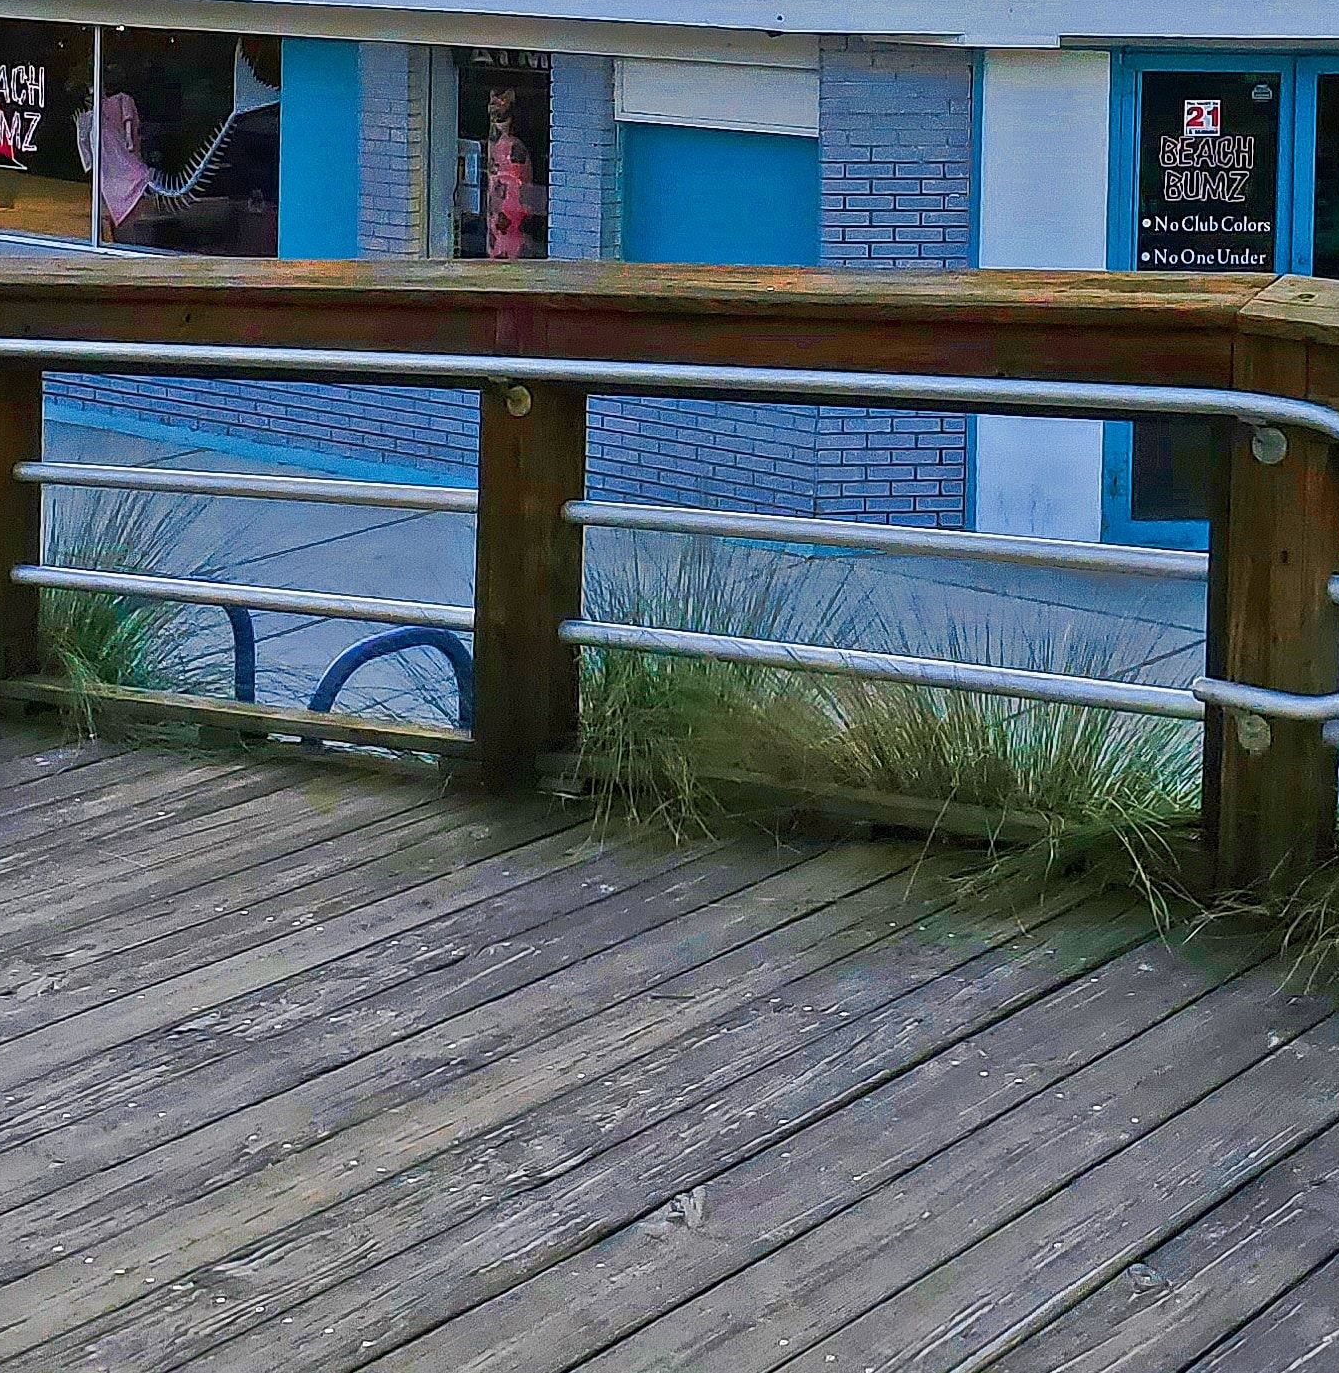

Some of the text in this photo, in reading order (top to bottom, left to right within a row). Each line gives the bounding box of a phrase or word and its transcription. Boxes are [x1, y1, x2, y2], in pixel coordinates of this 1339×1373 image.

[1186, 106, 1219, 127] 21
[1159, 135, 1254, 169] BEACH
[1164, 169, 1250, 202] BUMZ
[1154, 214, 1271, 232] No Club Colors
[1154, 247, 1267, 265] No One Under
